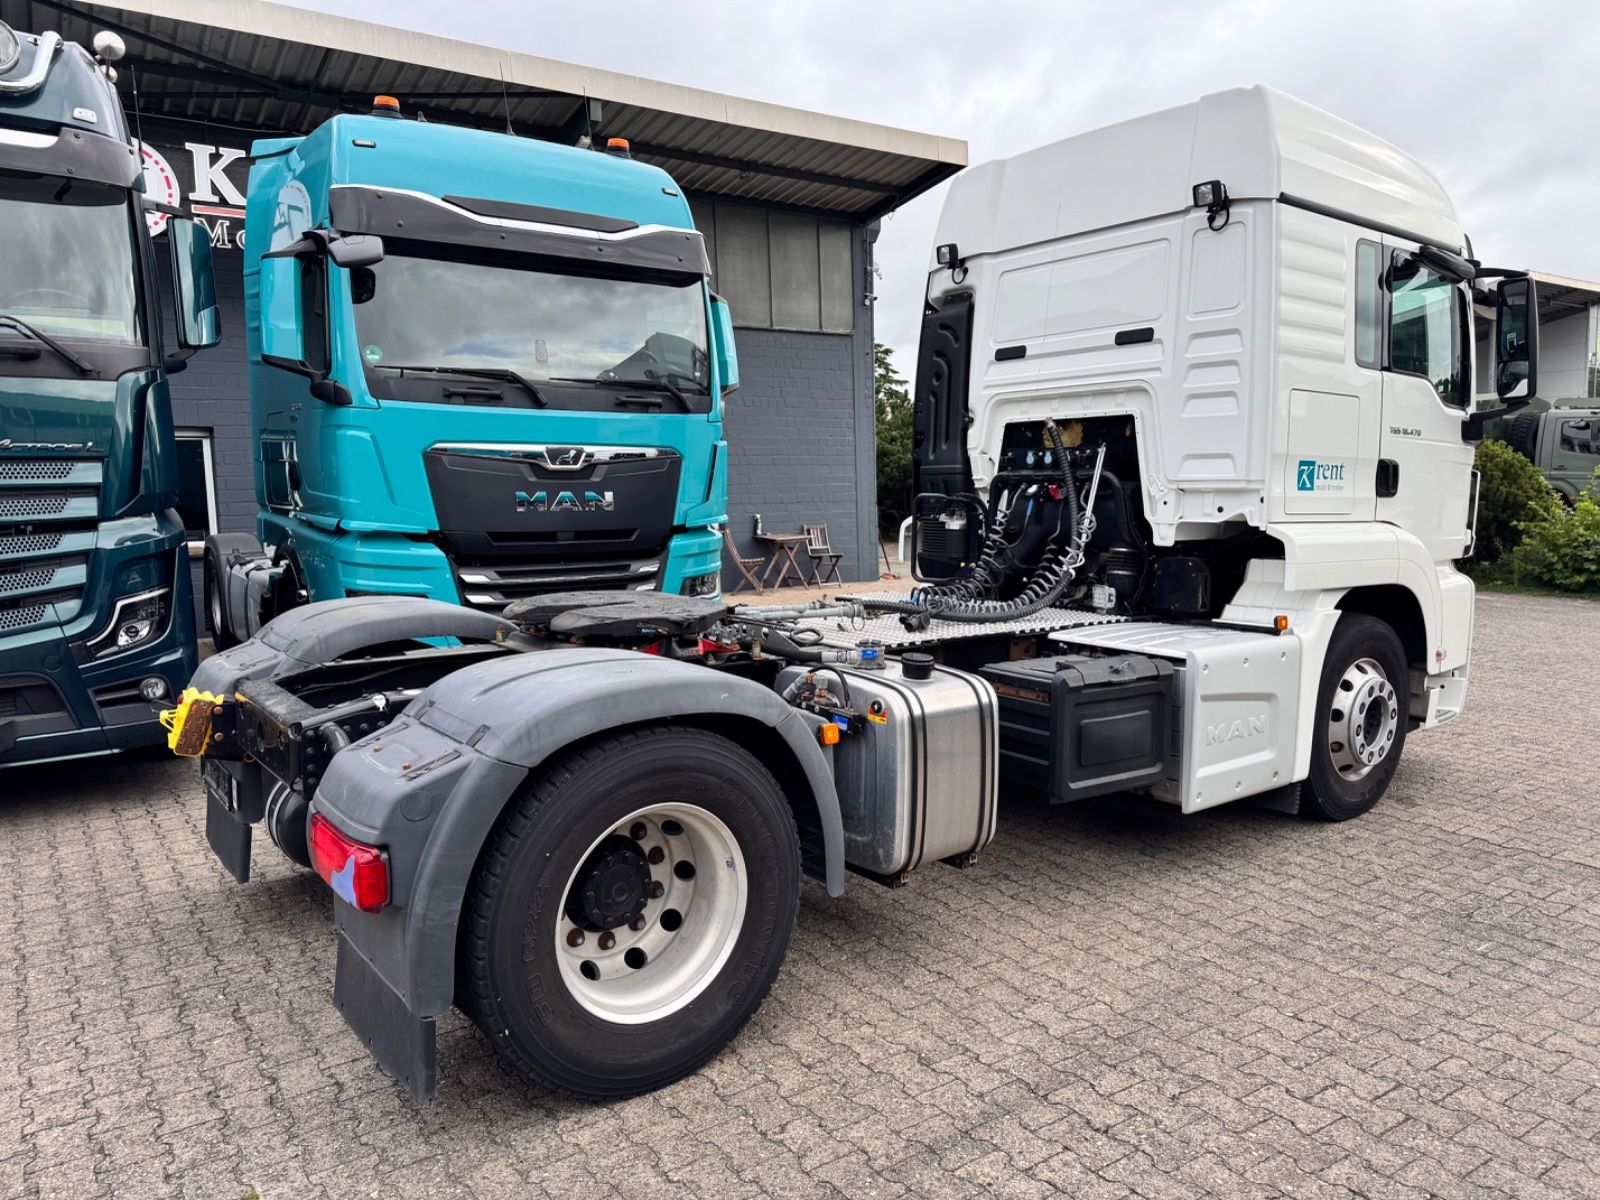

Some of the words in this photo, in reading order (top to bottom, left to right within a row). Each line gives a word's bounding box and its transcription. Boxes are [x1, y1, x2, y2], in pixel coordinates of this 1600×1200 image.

[1316, 463, 1345, 480] rent
[515, 490, 615, 512] MAN
[1206, 714, 1265, 746] MAN
